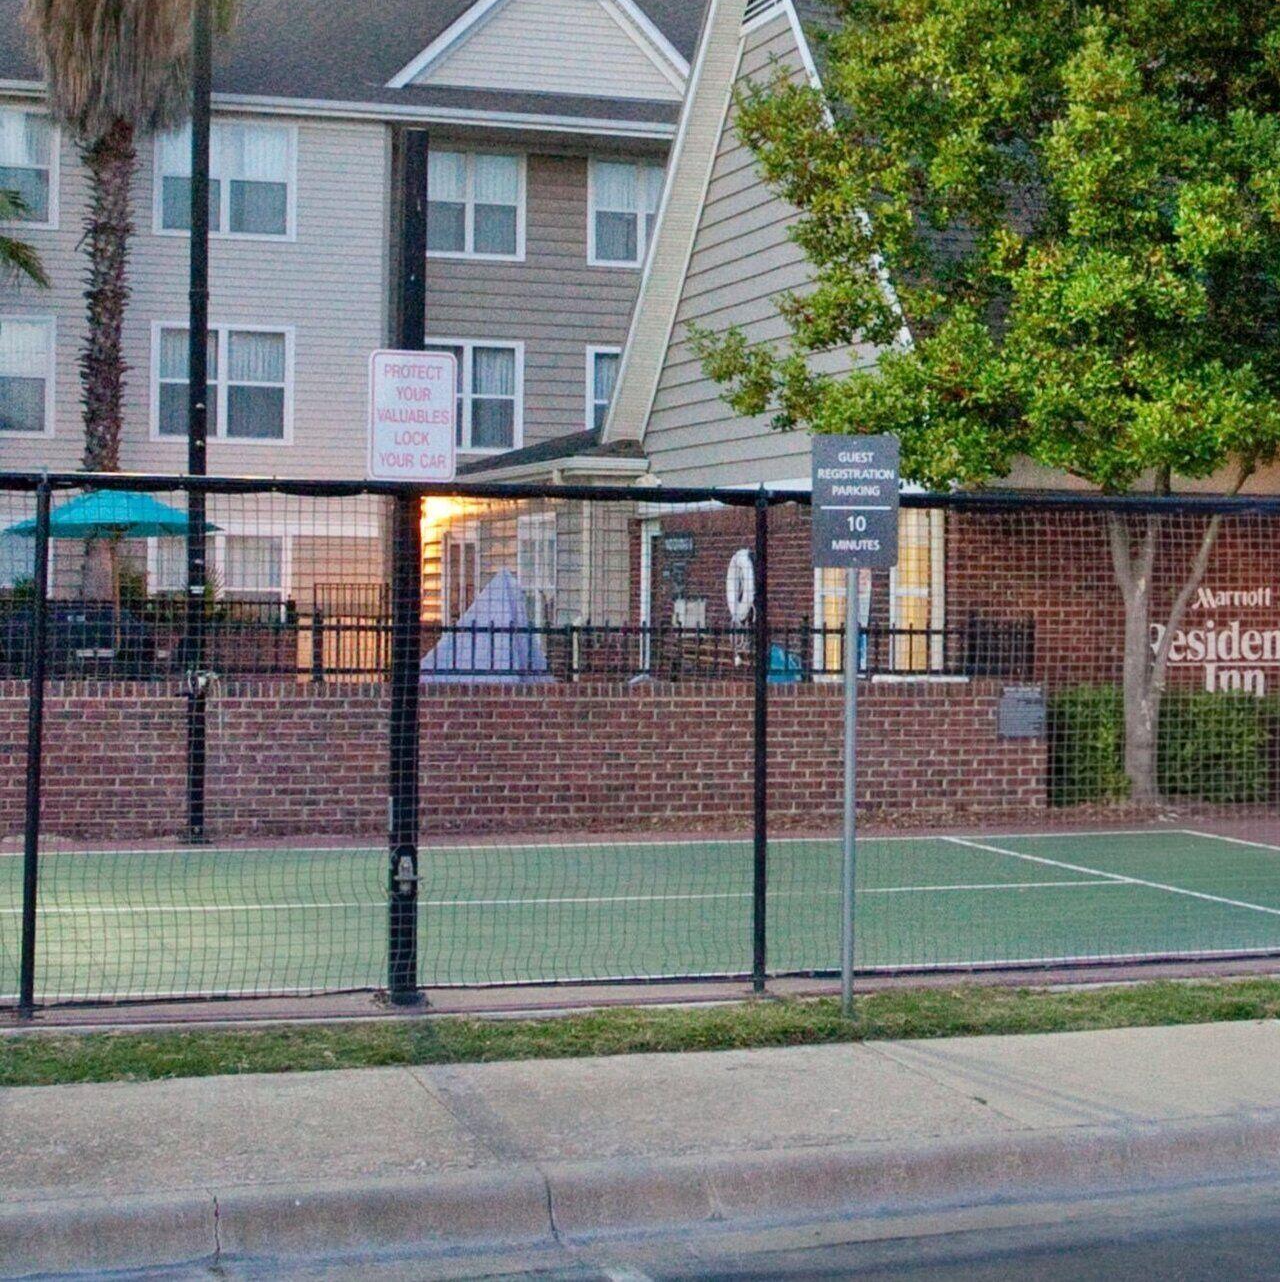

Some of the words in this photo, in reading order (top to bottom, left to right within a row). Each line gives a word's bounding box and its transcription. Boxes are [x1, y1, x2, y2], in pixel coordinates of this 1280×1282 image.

[384, 363, 443, 380] PROTECT
[396, 387, 431, 401] YOUR
[377, 409, 449, 425] VALUABLES
[394, 431, 430, 446] LOCK
[379, 453, 414, 468] YOUR
[419, 454, 446, 469] CAR
[838, 452, 875, 463] GUEST
[817, 469, 895, 480] REGISTRATION
[832, 486, 880, 496] PARKING
[847, 516, 867, 532] 10
[832, 540, 880, 550] MINUTES
[1191, 587, 1271, 609] Marriott
